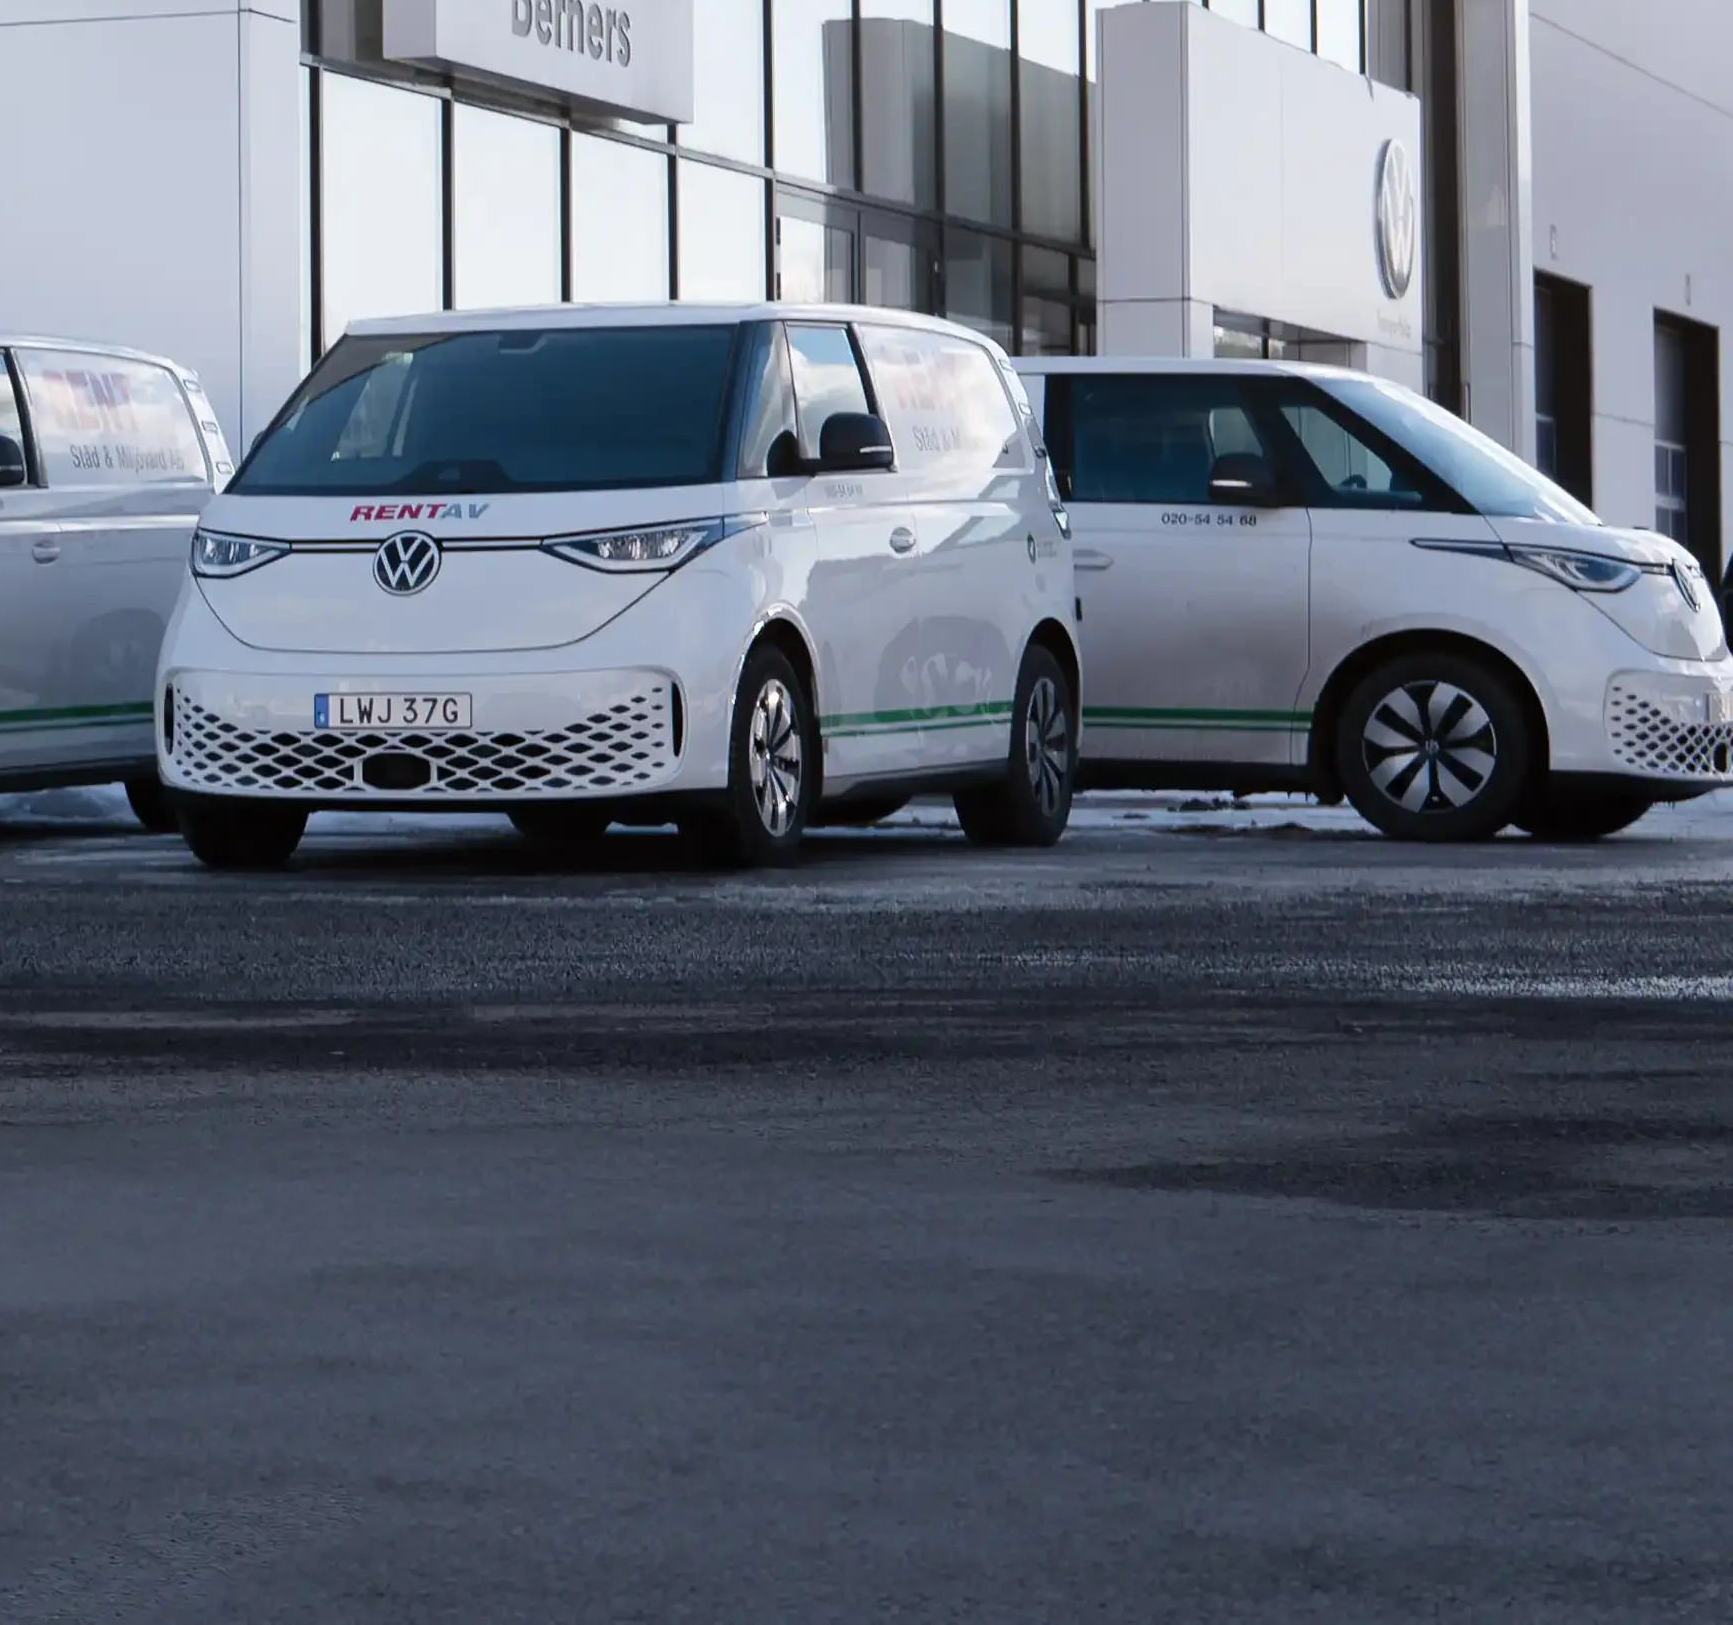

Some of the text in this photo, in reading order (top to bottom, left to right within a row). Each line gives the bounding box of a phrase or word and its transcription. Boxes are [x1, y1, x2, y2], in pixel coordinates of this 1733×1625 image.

[350, 503, 490, 522] RENTAV
[339, 697, 459, 724] LWJ 37G
